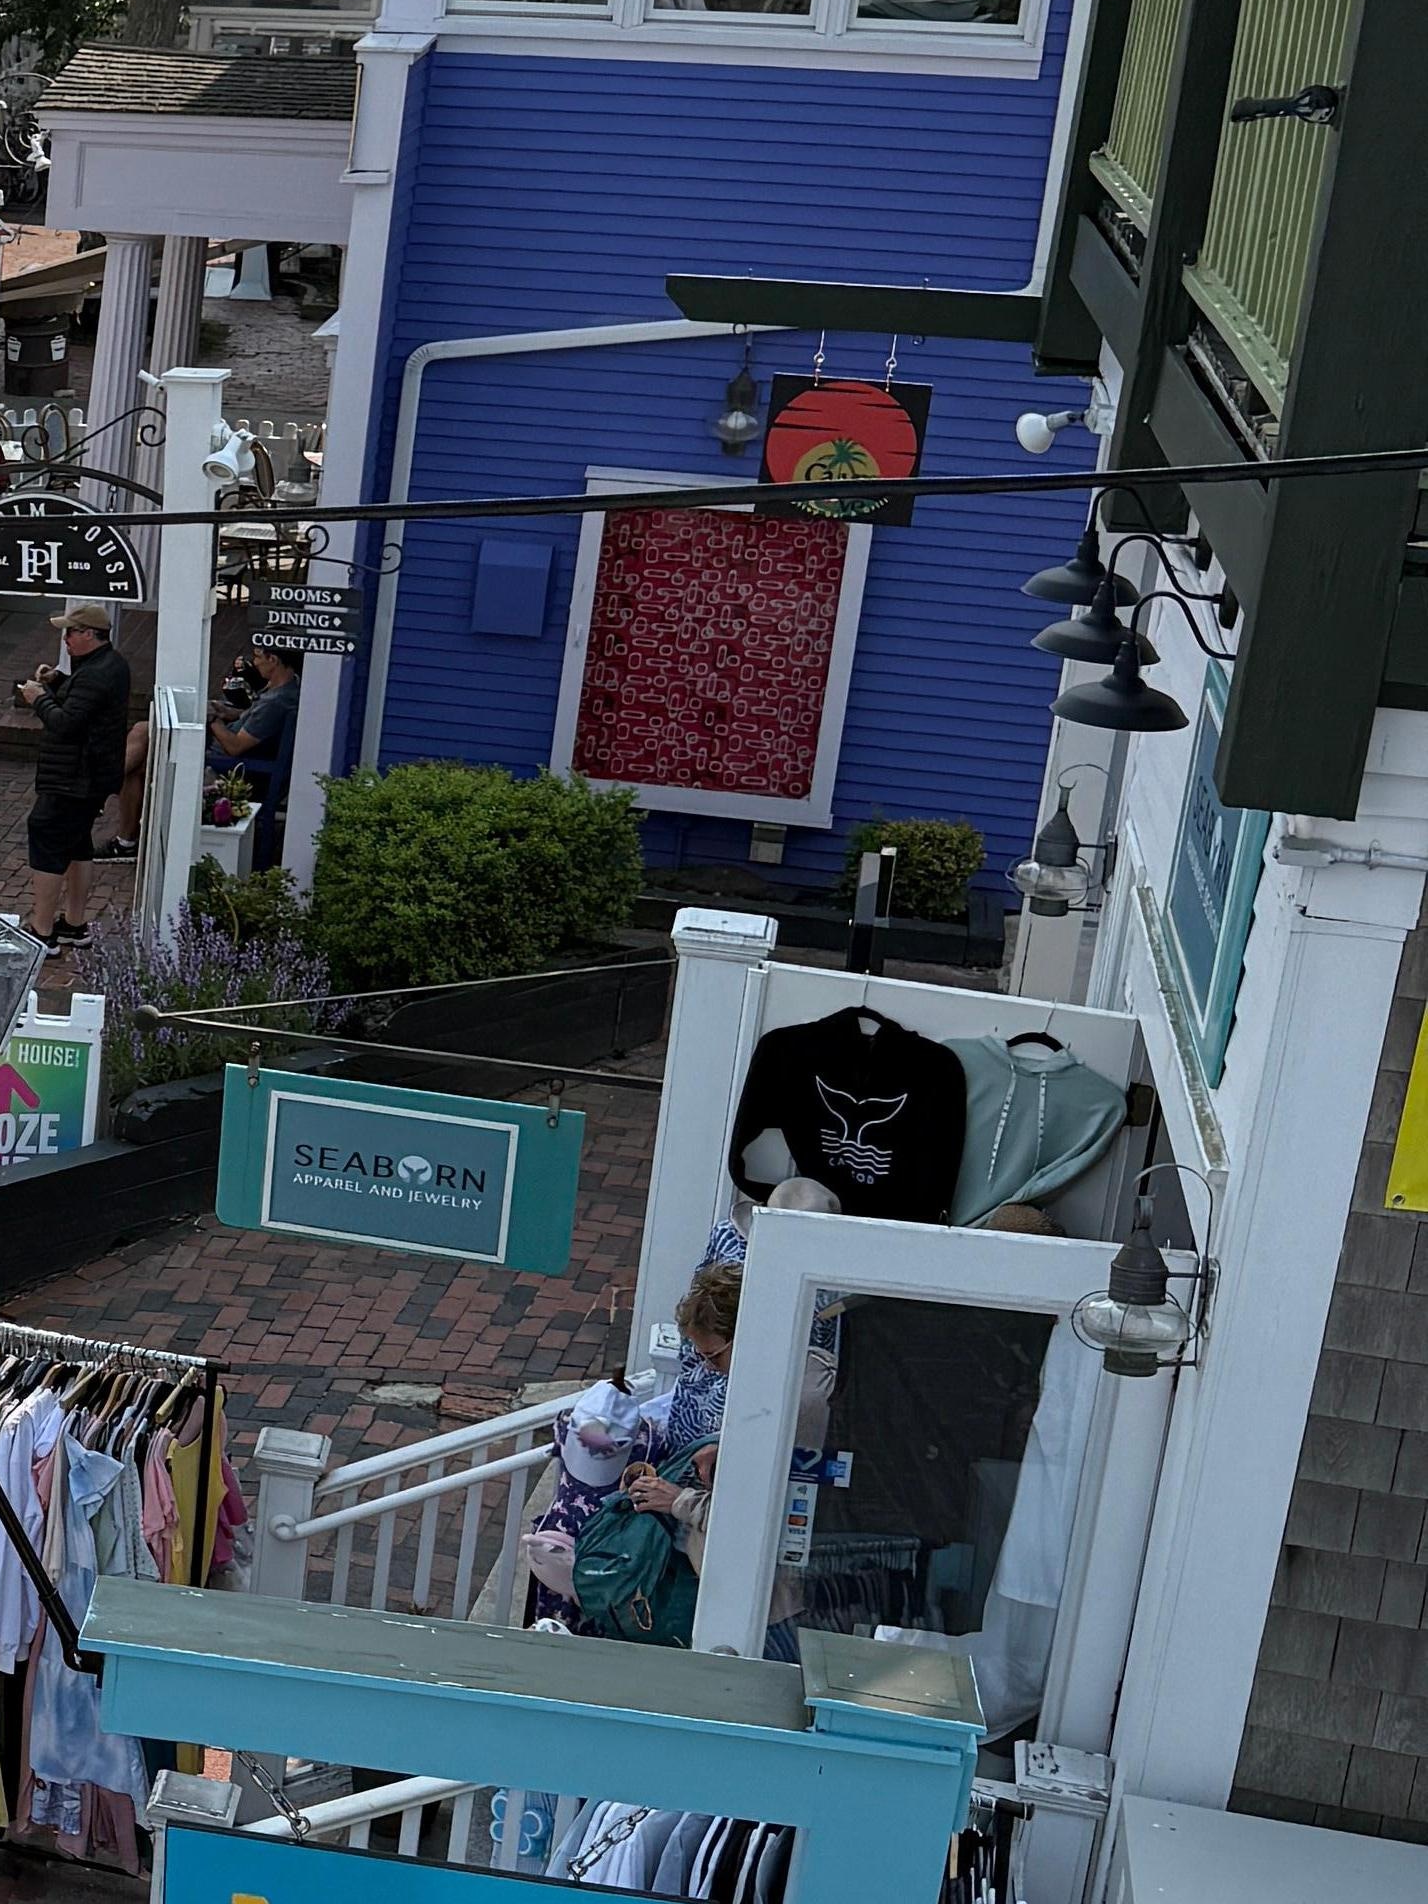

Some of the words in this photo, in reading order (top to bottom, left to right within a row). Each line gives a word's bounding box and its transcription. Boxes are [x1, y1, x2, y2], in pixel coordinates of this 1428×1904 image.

[270, 586, 332, 604] ROOMS
[267, 610, 330, 628] DINING
[251, 632, 346, 653] COCKTAILS
[293, 1143, 486, 1194] SEABORN
[293, 1172, 363, 1195] APPAREL
[368, 1183, 403, 1200] AND
[408, 1189, 483, 1211] JEWELRY
